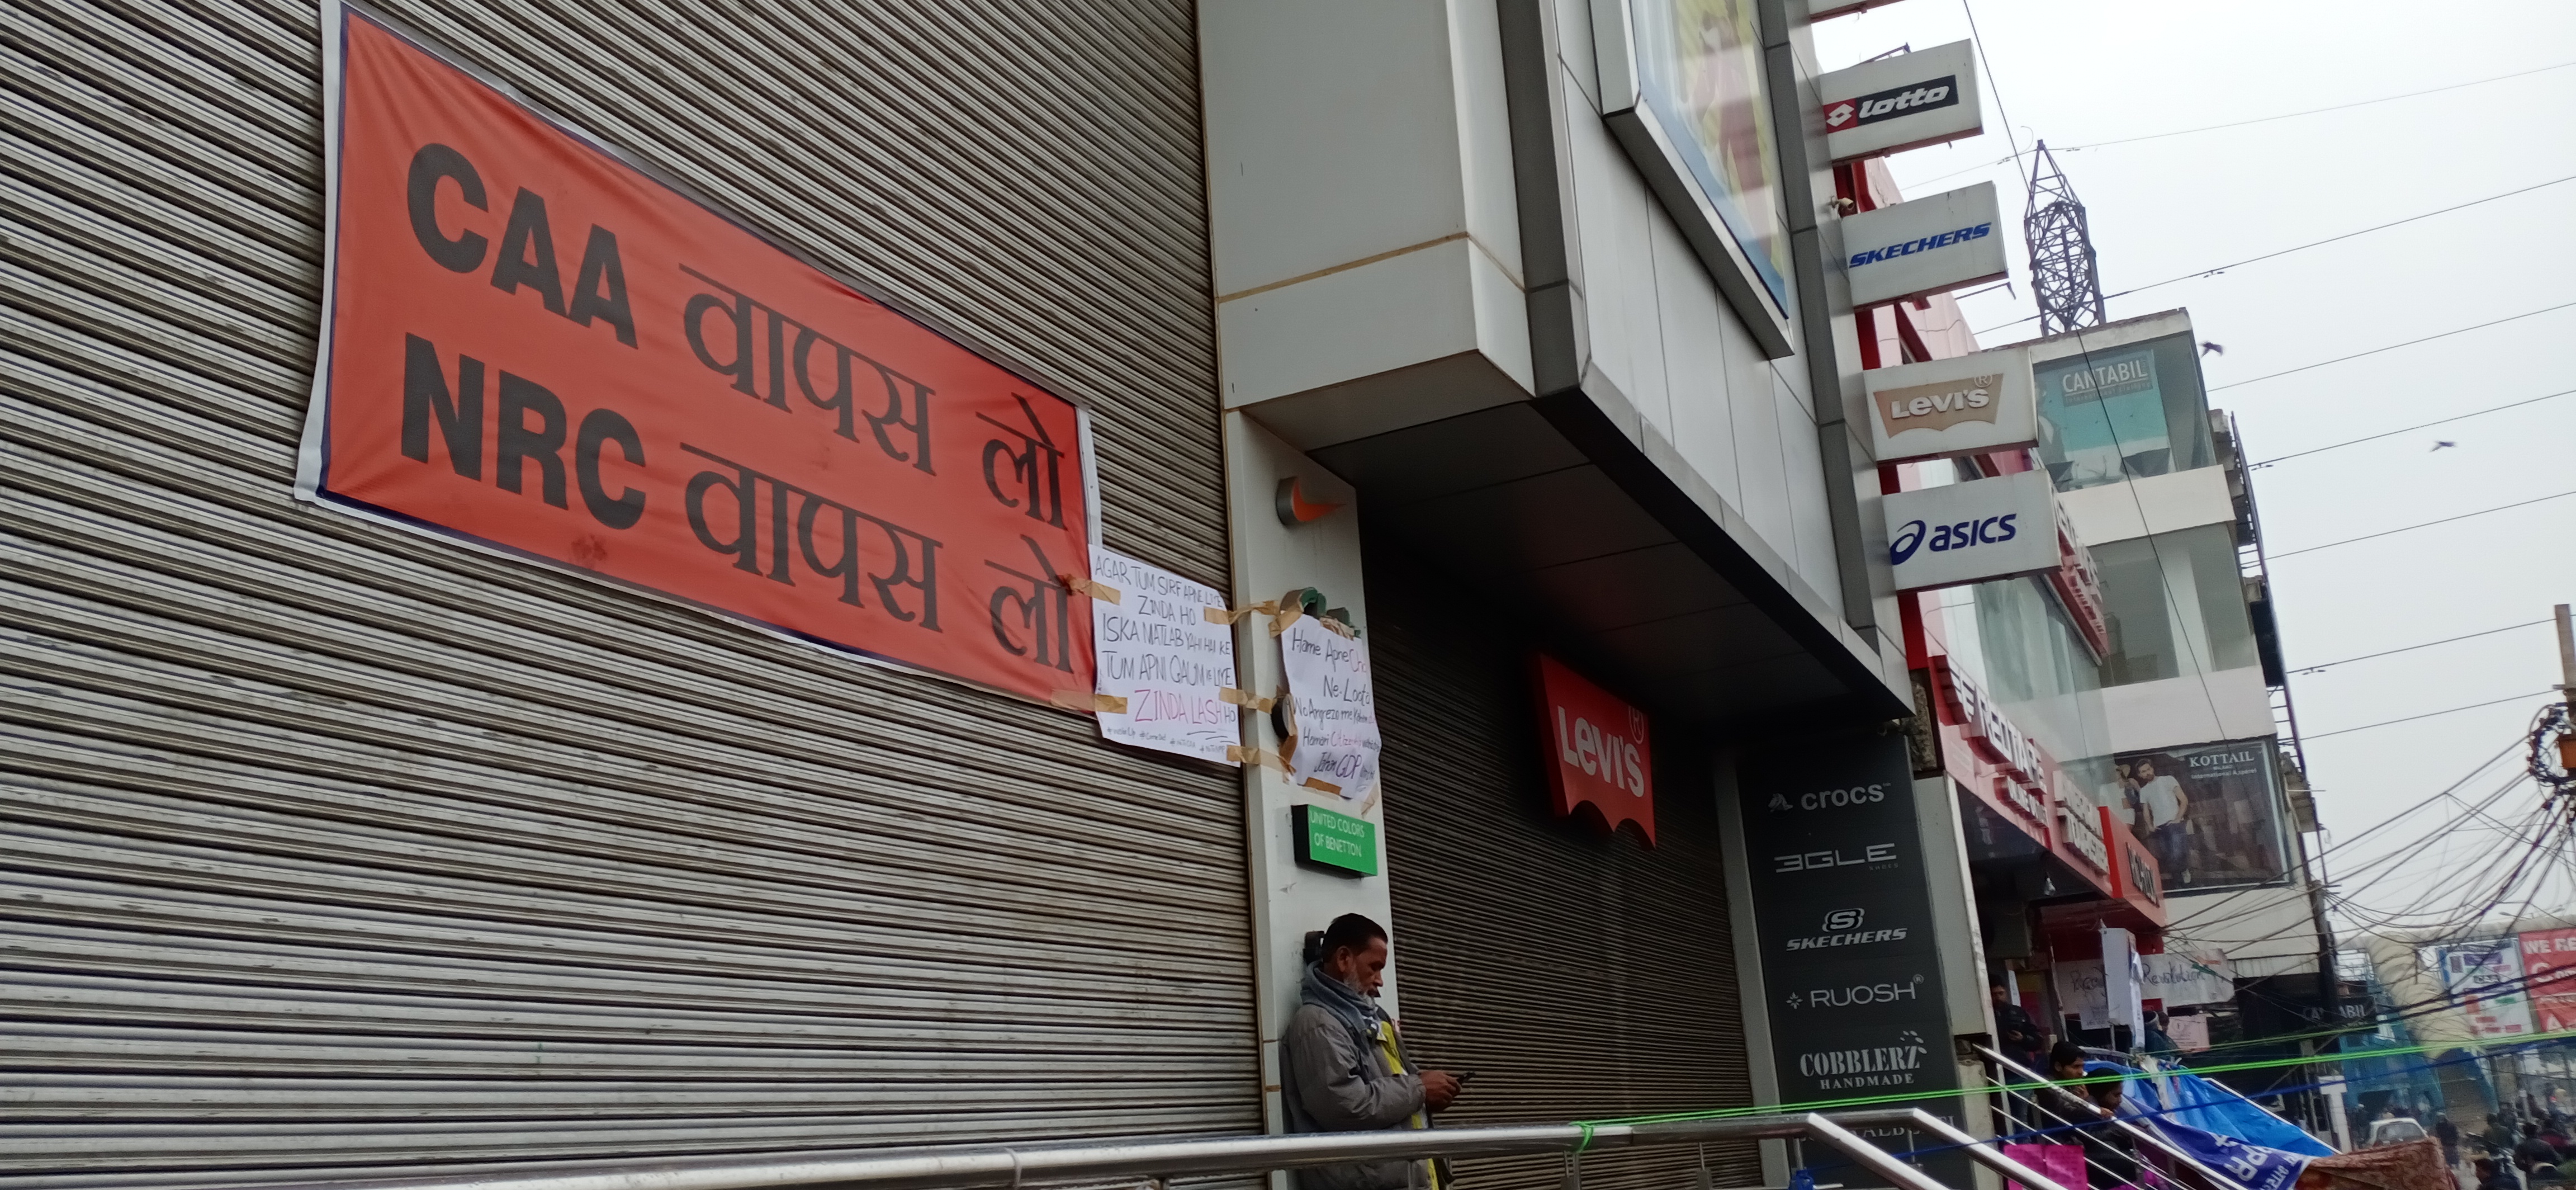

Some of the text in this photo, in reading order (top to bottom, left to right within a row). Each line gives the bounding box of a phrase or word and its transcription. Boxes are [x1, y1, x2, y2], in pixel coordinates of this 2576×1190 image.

[1859, 85, 1950, 120] lotto
[1848, 222, 1992, 269] SKECHERS
[407, 142, 1068, 530] CAA वापस लो
[2062, 360, 2148, 393] CANTABIL
[401, 332, 1073, 674] NRC वापस लो
[1095, 556, 1131, 585] AGAR
[1131, 565, 1155, 591] TUM
[1157, 576, 1181, 597] SIRF
[1183, 585, 1204, 603] APNE
[1138, 595, 1196, 626] ZINDA HO
[1102, 613, 1140, 643] ISKA
[1143, 621, 1184, 647] MATLAB
[1219, 641, 1230, 655] KE
[1101, 650, 1134, 680] TUM
[1139, 654, 1167, 682] APNI
[1134, 688, 1186, 723] ZINDA
[1191, 696, 1222, 725] LASH
[2188, 750, 2255, 767] KOTTAIL
[1801, 783, 1884, 811] crocs
[1309, 811, 1365, 838] UNITED COLORS
[1314, 833, 1362, 857] OF BENETTON
[1786, 928, 1908, 951] SKECHERS
[1810, 981, 1916, 1007] RUOSH
[1799, 1043, 1921, 1077] COBBLERZ
[1820, 1073, 1914, 1090] HANDMADE
